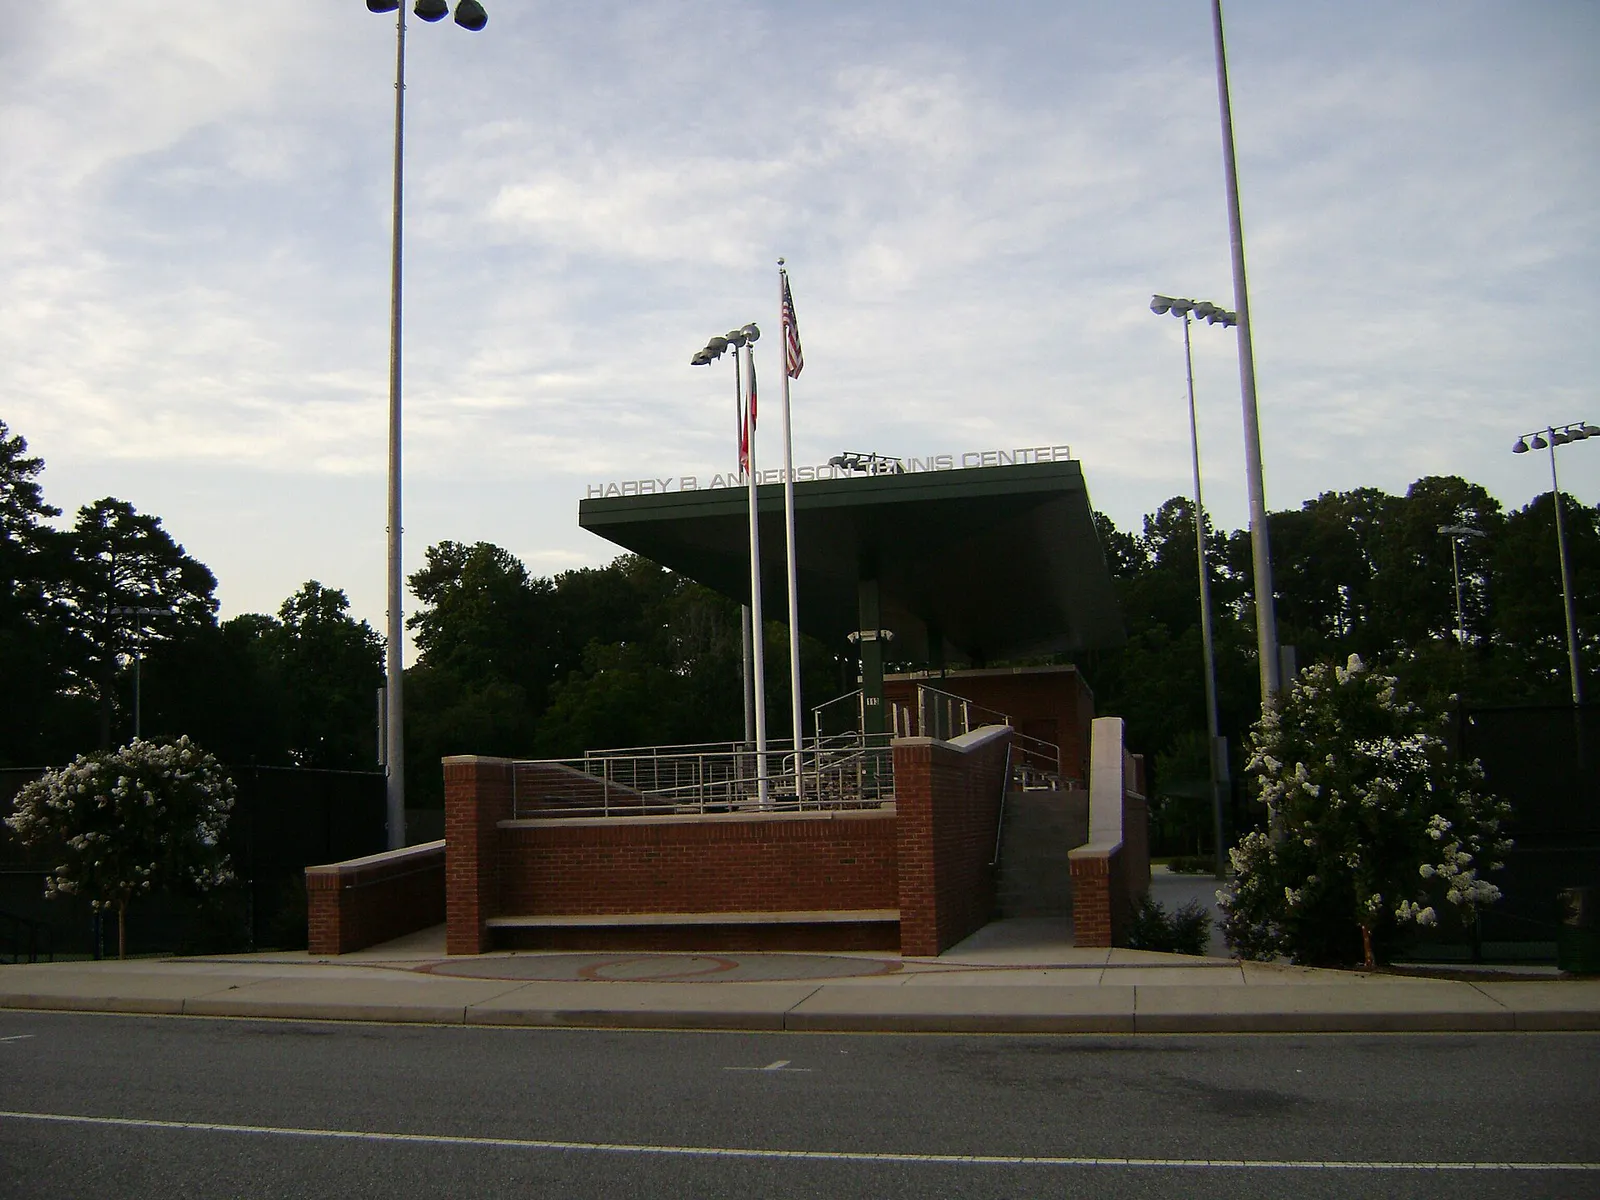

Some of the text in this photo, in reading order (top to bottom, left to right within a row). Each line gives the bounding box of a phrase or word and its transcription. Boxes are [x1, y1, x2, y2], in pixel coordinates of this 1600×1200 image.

[587, 477, 673, 499] HARRY
[680, 476, 702, 492] B.
[858, 454, 953, 476] TENNIS
[961, 445, 1071, 468] CENTER
